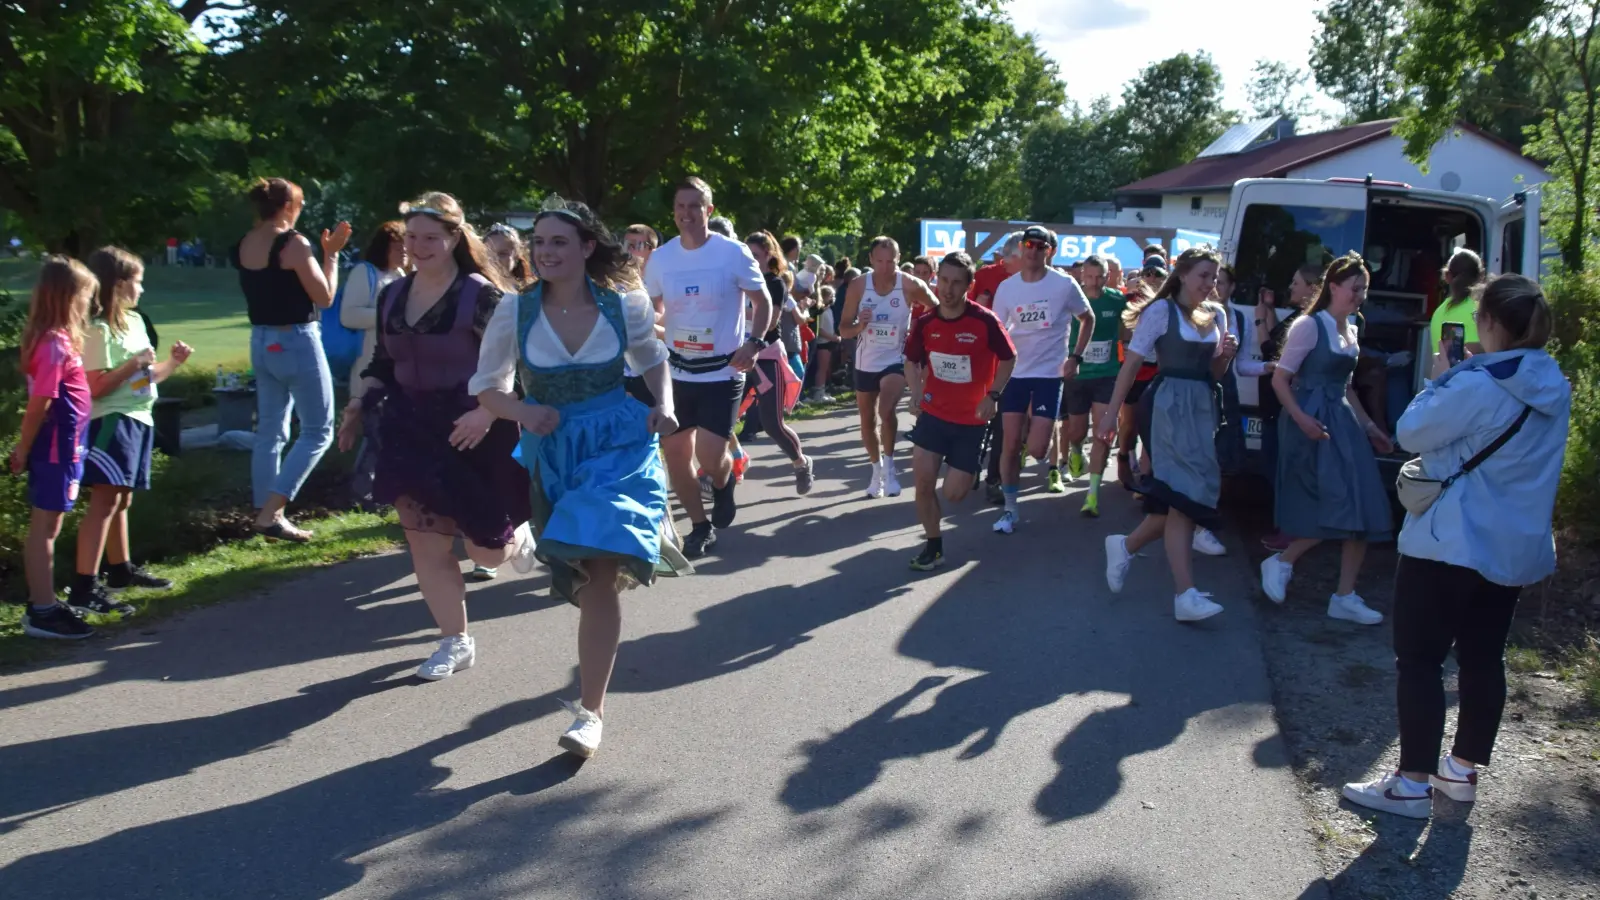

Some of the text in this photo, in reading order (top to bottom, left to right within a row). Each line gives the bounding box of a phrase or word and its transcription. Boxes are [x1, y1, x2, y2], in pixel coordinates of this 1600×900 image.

[1019, 311, 1046, 323] 2224
[687, 335, 698, 343] 48
[941, 360, 957, 370] 302
